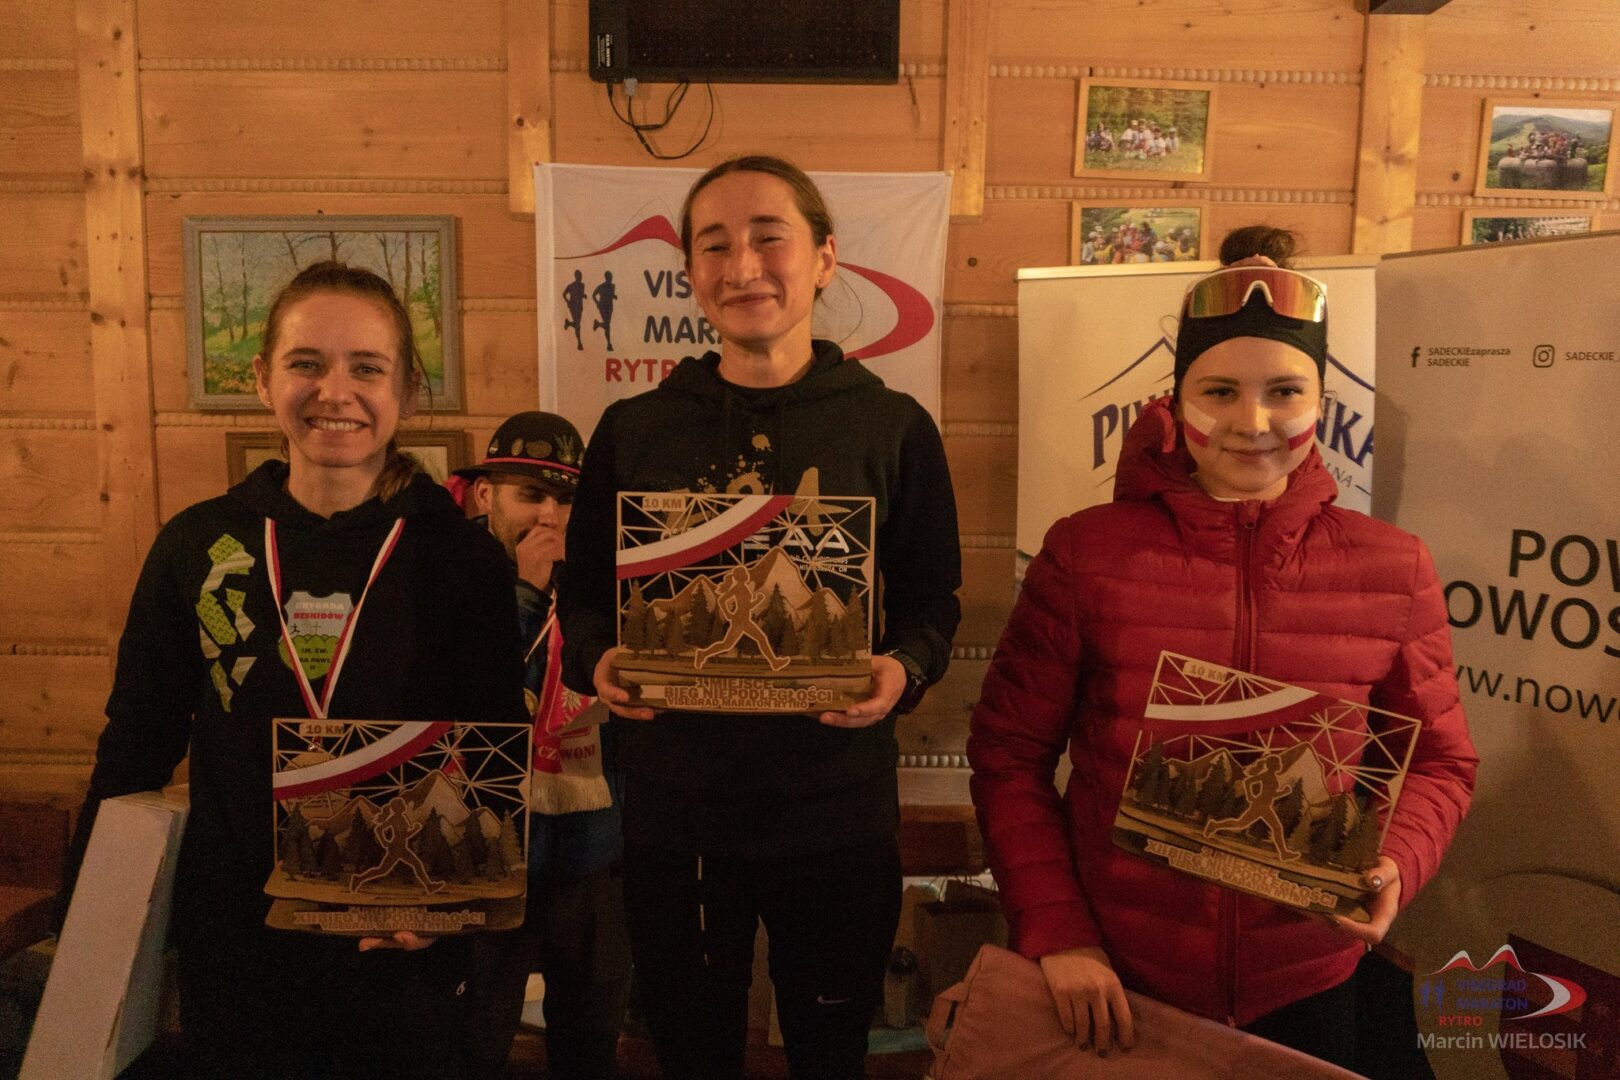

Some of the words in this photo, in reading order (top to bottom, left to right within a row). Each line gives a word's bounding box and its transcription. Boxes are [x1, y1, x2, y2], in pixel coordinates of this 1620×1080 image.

[643, 270, 693, 299] VIS
[643, 315, 723, 345] MAR
[644, 499, 659, 508] 10
[662, 499, 682, 509] KM
[1508, 528, 1620, 594] PO
[1190, 664, 1205, 676] 10
[664, 687, 699, 699] BIEG
[306, 725, 321, 734] 10
